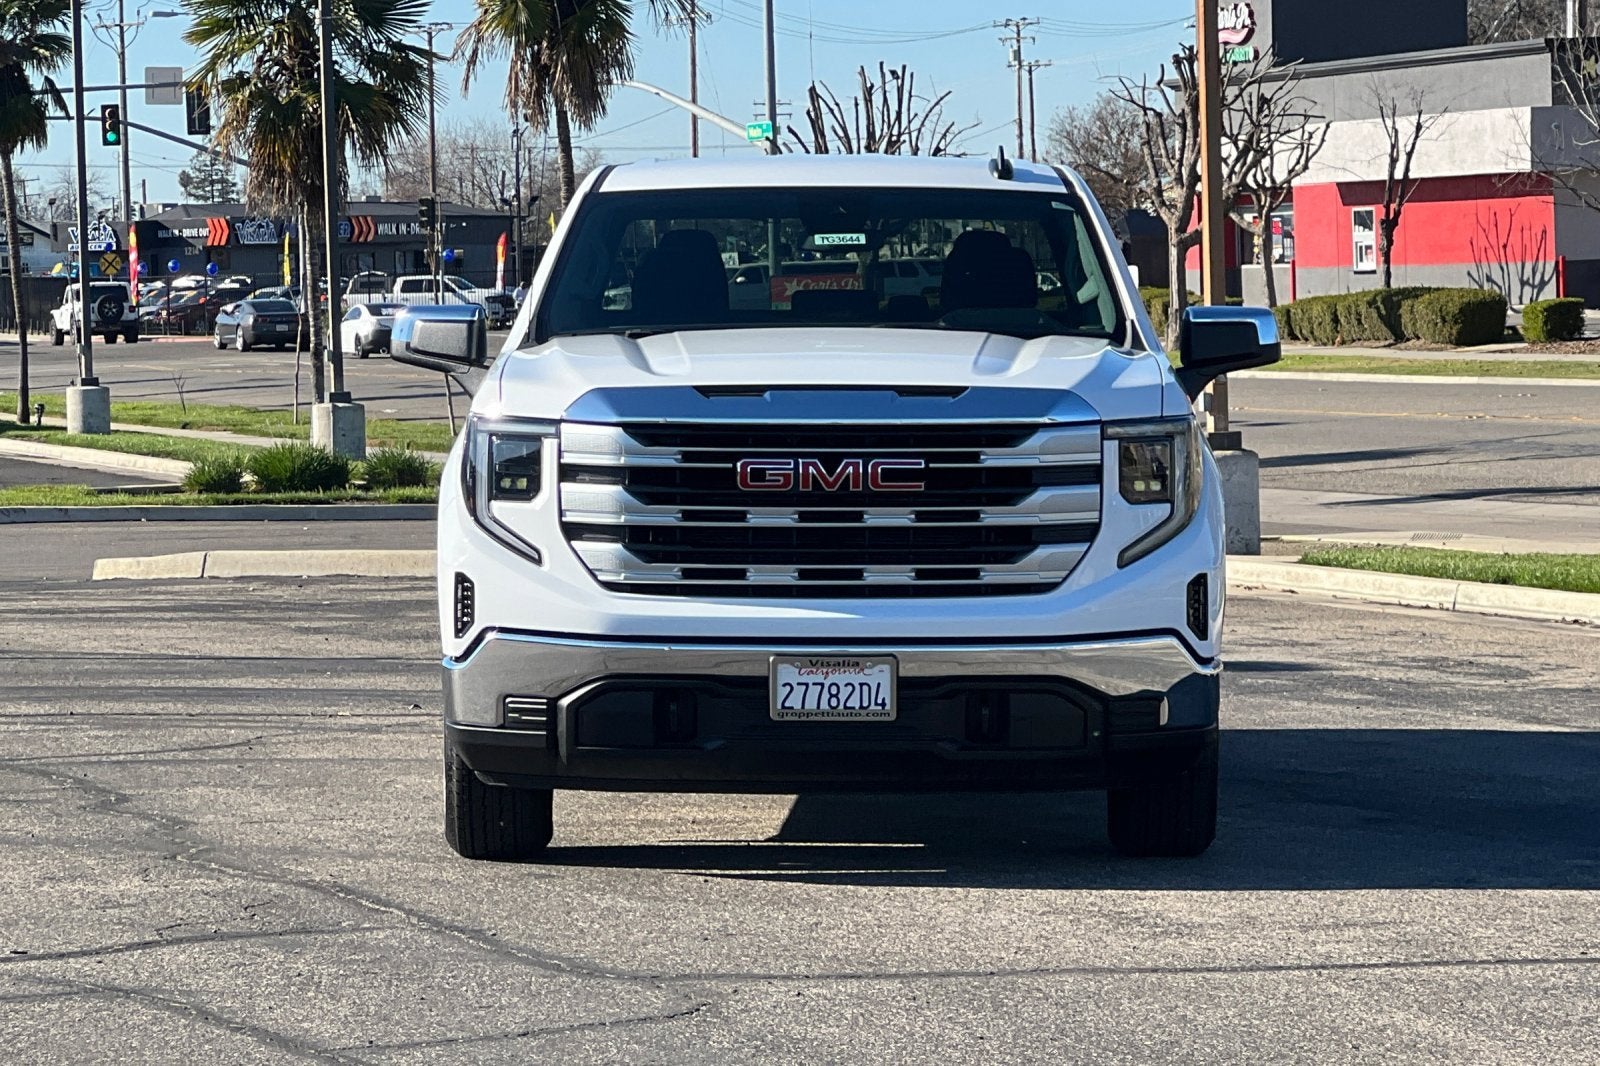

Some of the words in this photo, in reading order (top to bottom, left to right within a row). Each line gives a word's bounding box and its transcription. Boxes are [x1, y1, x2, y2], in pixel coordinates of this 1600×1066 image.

[198, 227, 210, 237] OUT
[377, 223, 397, 235] WALK
[819, 236, 861, 244] TG3644
[737, 458, 926, 492] GMC
[808, 659, 860, 668] Visalia
[797, 666, 873, 681] California
[780, 681, 888, 711] 27782D4
[777, 711, 891, 720] groppettiauto.com
